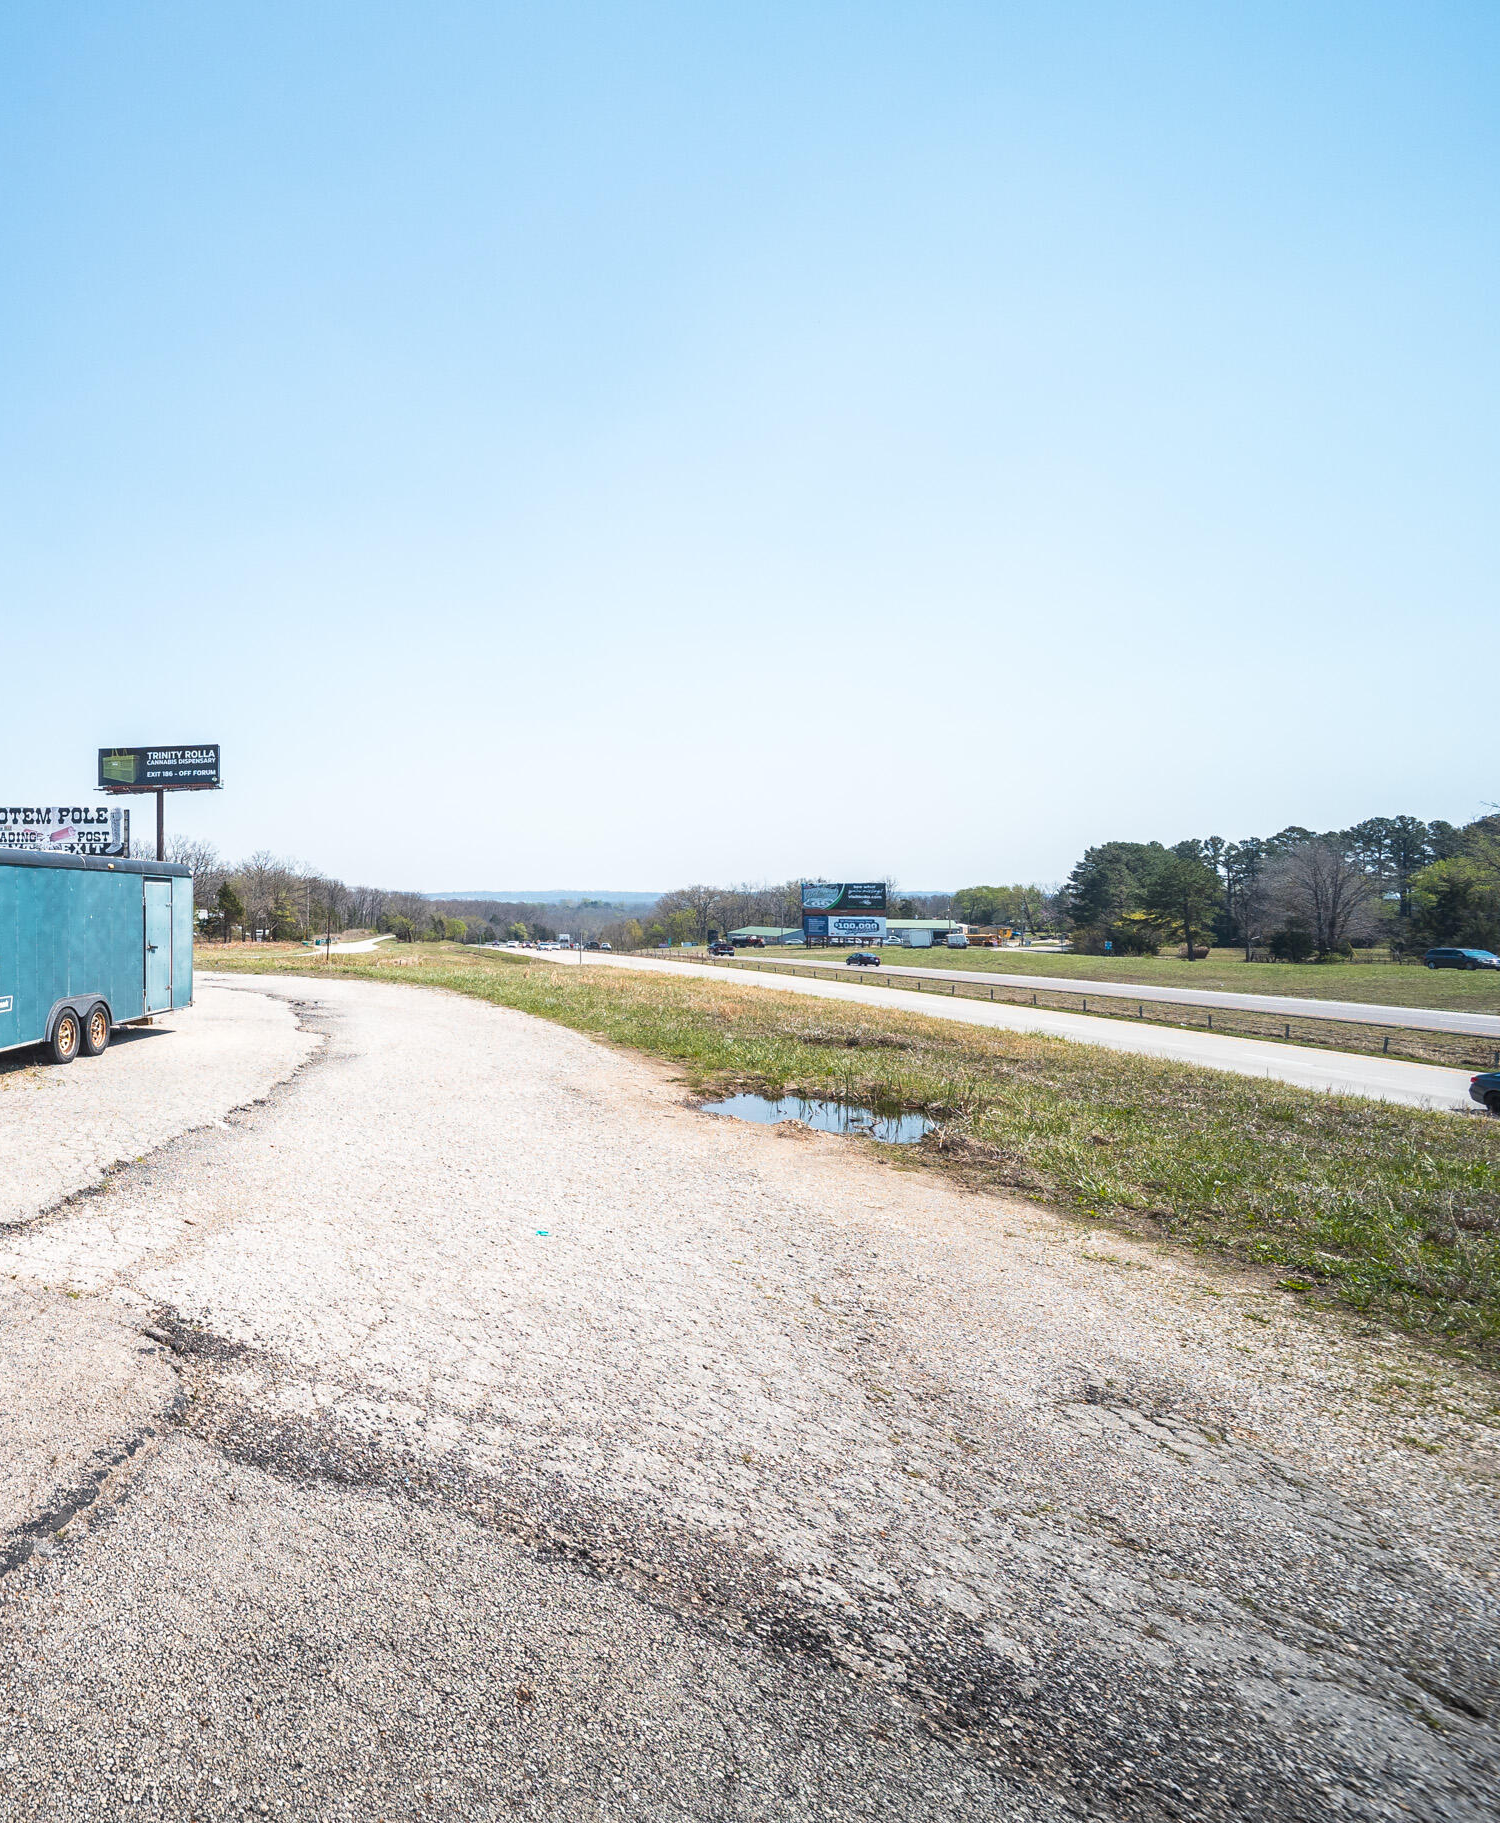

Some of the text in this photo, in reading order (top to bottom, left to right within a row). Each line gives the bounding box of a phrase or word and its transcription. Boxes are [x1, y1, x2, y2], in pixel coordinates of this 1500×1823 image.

[146, 749, 215, 760] TRINITY ROLLA
[178, 757, 216, 765] DISPENSARY
[57, 807, 109, 825] POLE
[77, 831, 110, 843] POST
[61, 843, 104, 854] EXIT
